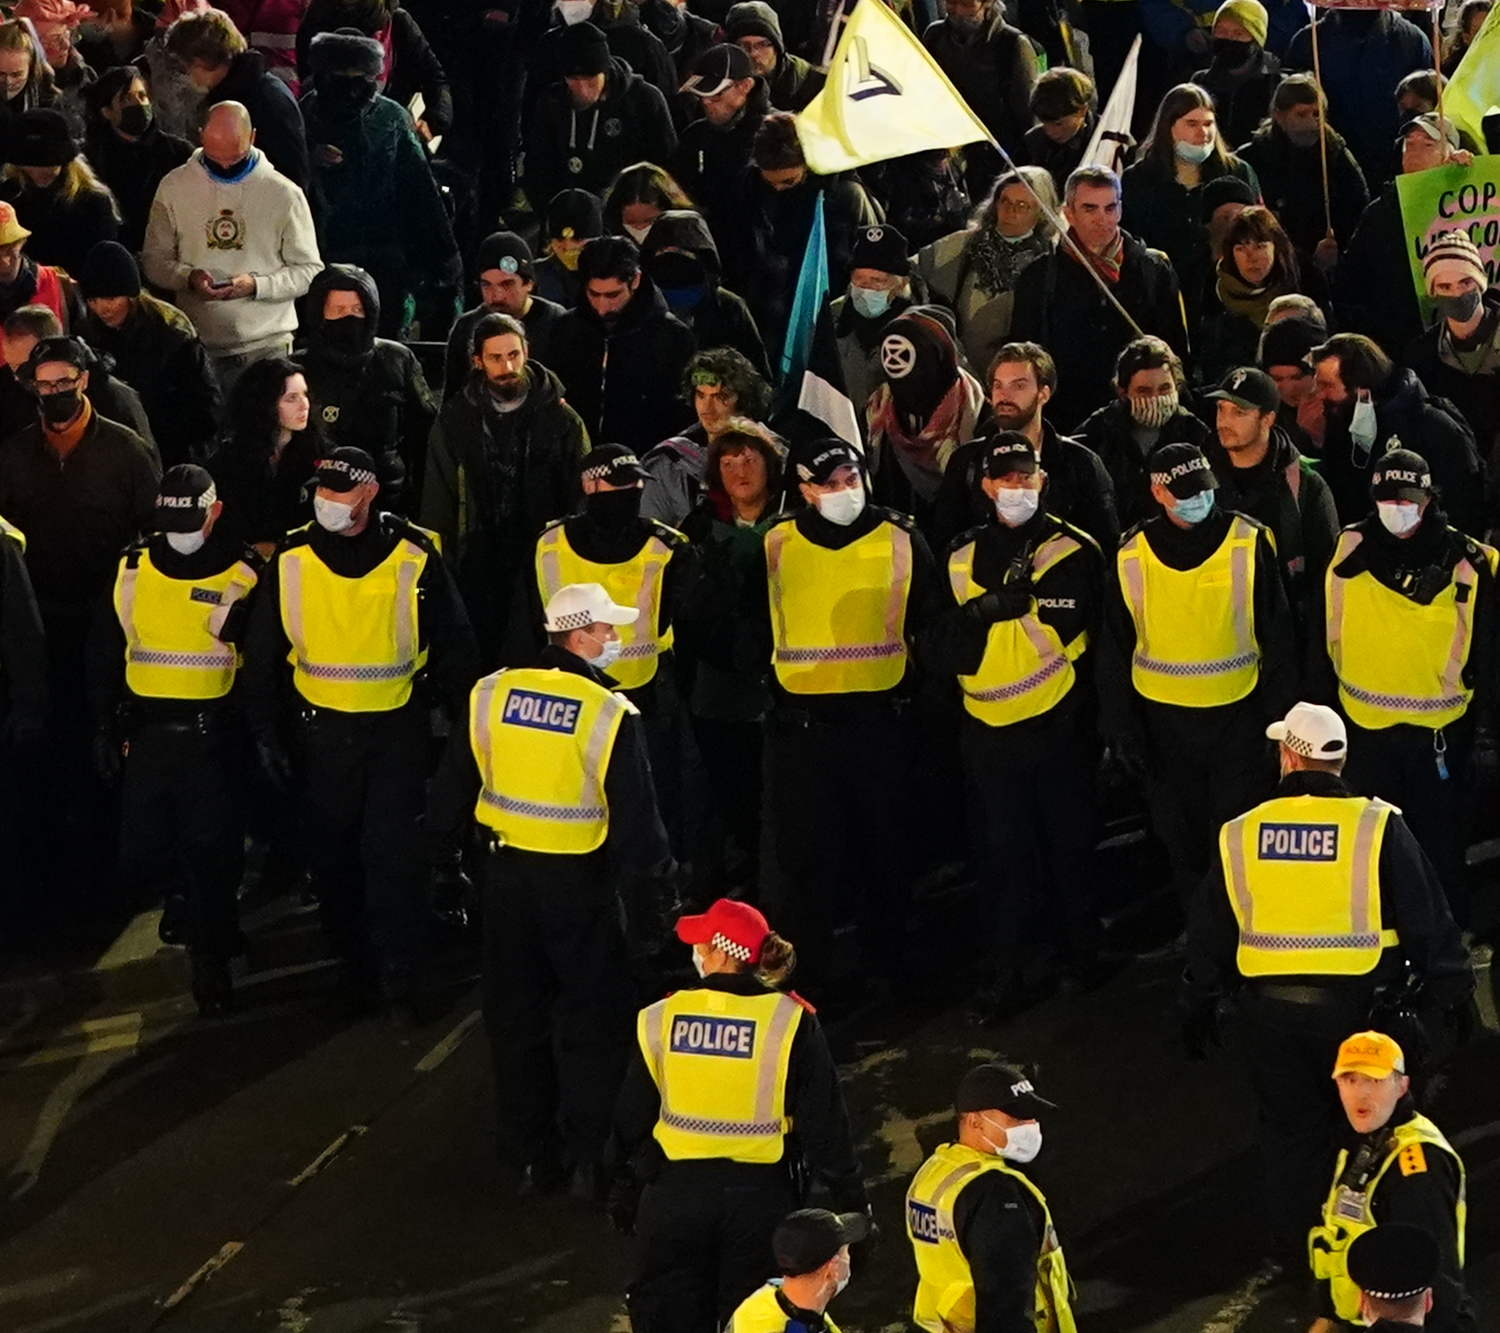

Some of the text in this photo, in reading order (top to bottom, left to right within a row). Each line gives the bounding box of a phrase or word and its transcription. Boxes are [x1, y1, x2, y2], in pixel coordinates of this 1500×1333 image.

[1438, 181, 1496, 219] COP
[813, 446, 845, 467] POLICE
[993, 443, 1028, 456] POLICE
[319, 458, 349, 474] POLICE
[1170, 459, 1204, 480] POLICE
[1385, 470, 1417, 483] POLICE
[163, 495, 193, 508] POLICE
[1038, 598, 1076, 609] POLICE
[504, 691, 580, 733] POLICE
[1260, 827, 1337, 857] POLICE
[673, 1019, 753, 1057] POLICE
[1344, 1044, 1383, 1058] POLICE
[1011, 1080, 1035, 1097] POLI
